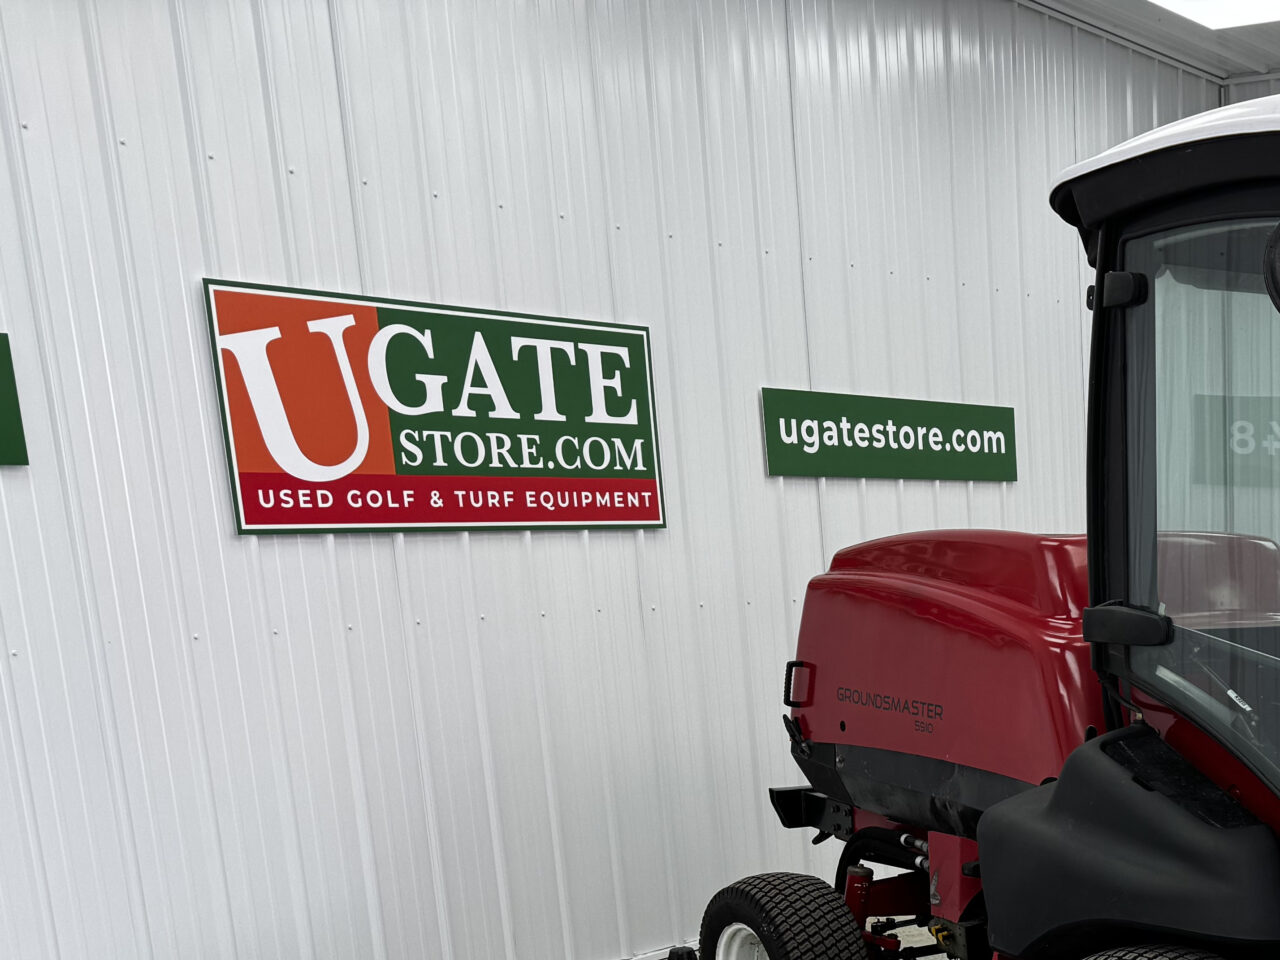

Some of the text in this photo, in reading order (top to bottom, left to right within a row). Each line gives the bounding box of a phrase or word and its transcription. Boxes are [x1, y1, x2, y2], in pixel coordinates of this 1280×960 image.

[399, 429, 648, 471] STORE.COM
[778, 416, 1006, 454] ugatestore.com
[257, 489, 653, 511] USED GOLF & TURF EQUIPMENT
[836, 687, 944, 720] GROUNDSMASTER
